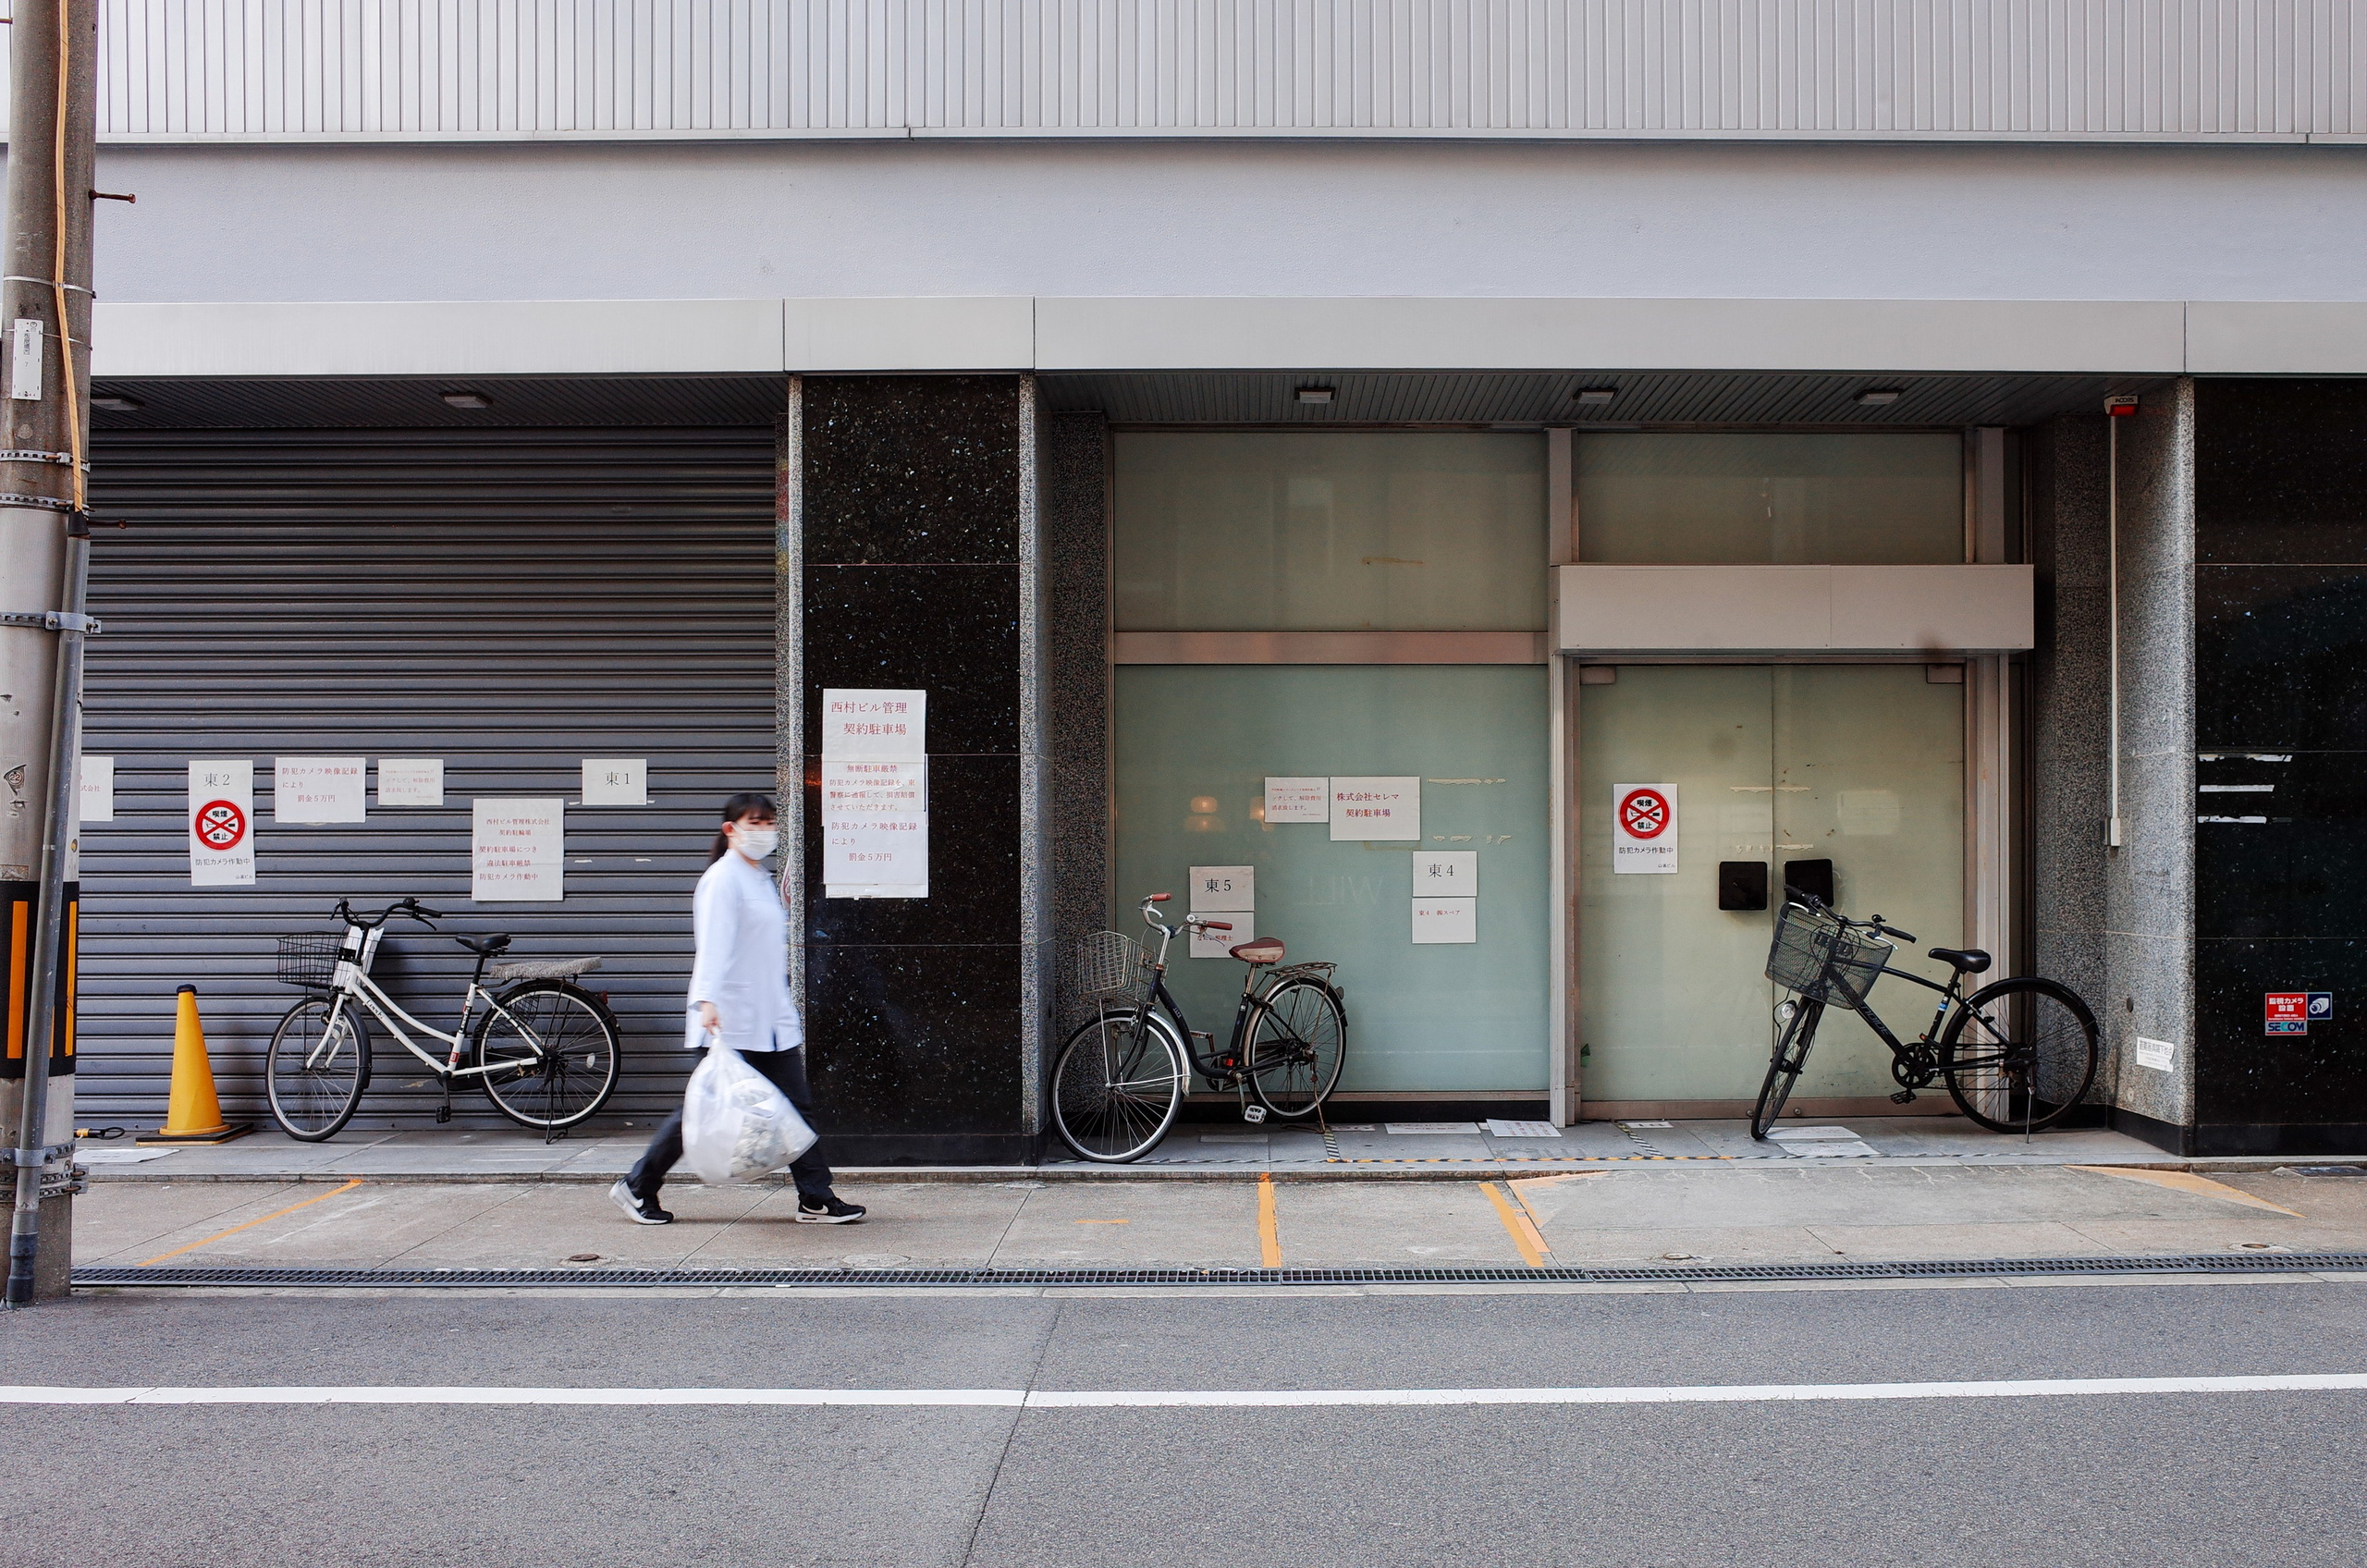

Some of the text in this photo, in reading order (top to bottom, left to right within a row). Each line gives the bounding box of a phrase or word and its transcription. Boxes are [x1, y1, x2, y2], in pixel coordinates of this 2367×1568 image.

[831, 701, 907, 714] 西村ビル管理
[843, 723, 907, 735] 契約駐車場
[282, 767, 359, 776] 防犯カメラ映像記録
[847, 765, 898, 773] 無断駐車厳禁
[298, 794, 336, 802] 罰金5万円
[1336, 792, 1400, 802] 株式会社セレマ
[1637, 799, 1652, 807] 喫煙
[1345, 809, 1391, 818] 契約駐車場
[831, 822, 917, 831] 防犯カメラ映像記録
[195, 858, 251, 866] 防犯カメラ作動中
[1428, 864, 1454, 877] 東4
[1205, 878, 1232, 893] 東5
[2267, 1022, 2304, 1032] SECOM
